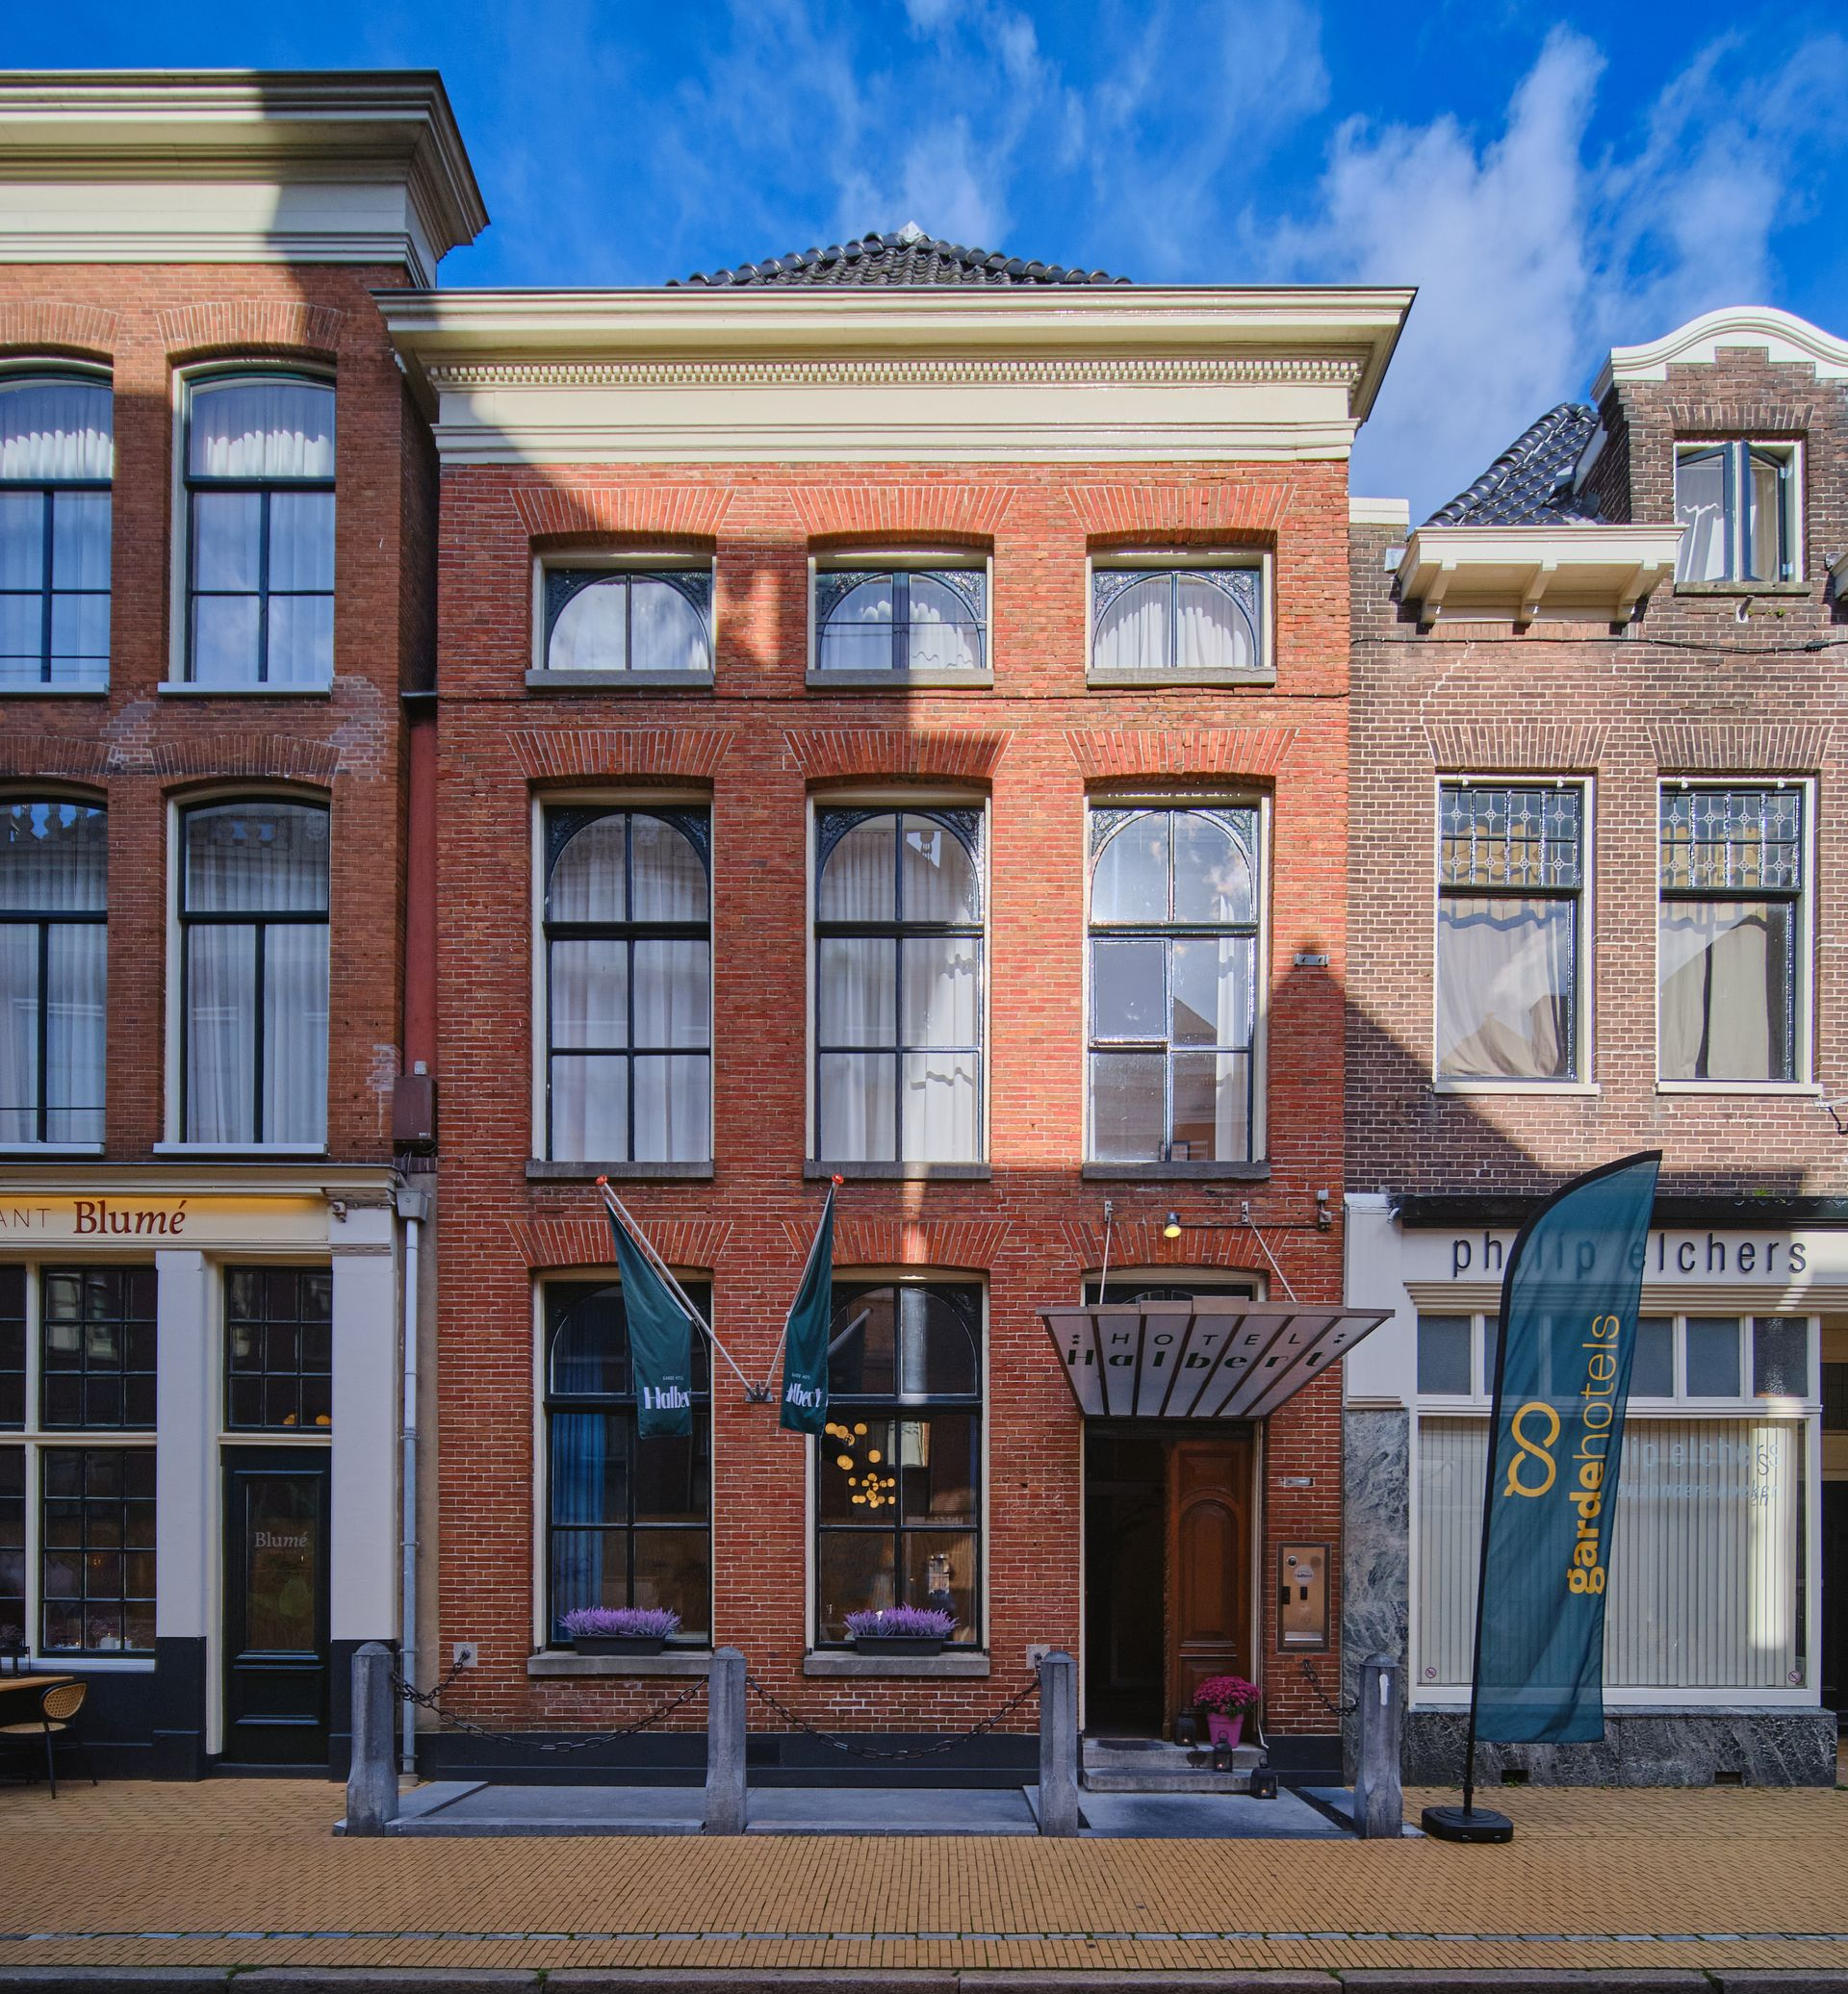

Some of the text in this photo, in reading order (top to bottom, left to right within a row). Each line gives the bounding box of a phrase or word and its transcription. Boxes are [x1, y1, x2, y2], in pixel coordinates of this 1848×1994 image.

[73, 1200, 188, 1235] Blumé
[1452, 1231, 1808, 1279] phlip elchers
[1111, 1333, 1301, 1346] HOTEL
[1067, 1348, 1324, 1369] Halbert
[643, 1385, 692, 1410] Halber
[1567, 1314, 1620, 1595] gardehotels
[254, 1531, 309, 1548] Blumé
